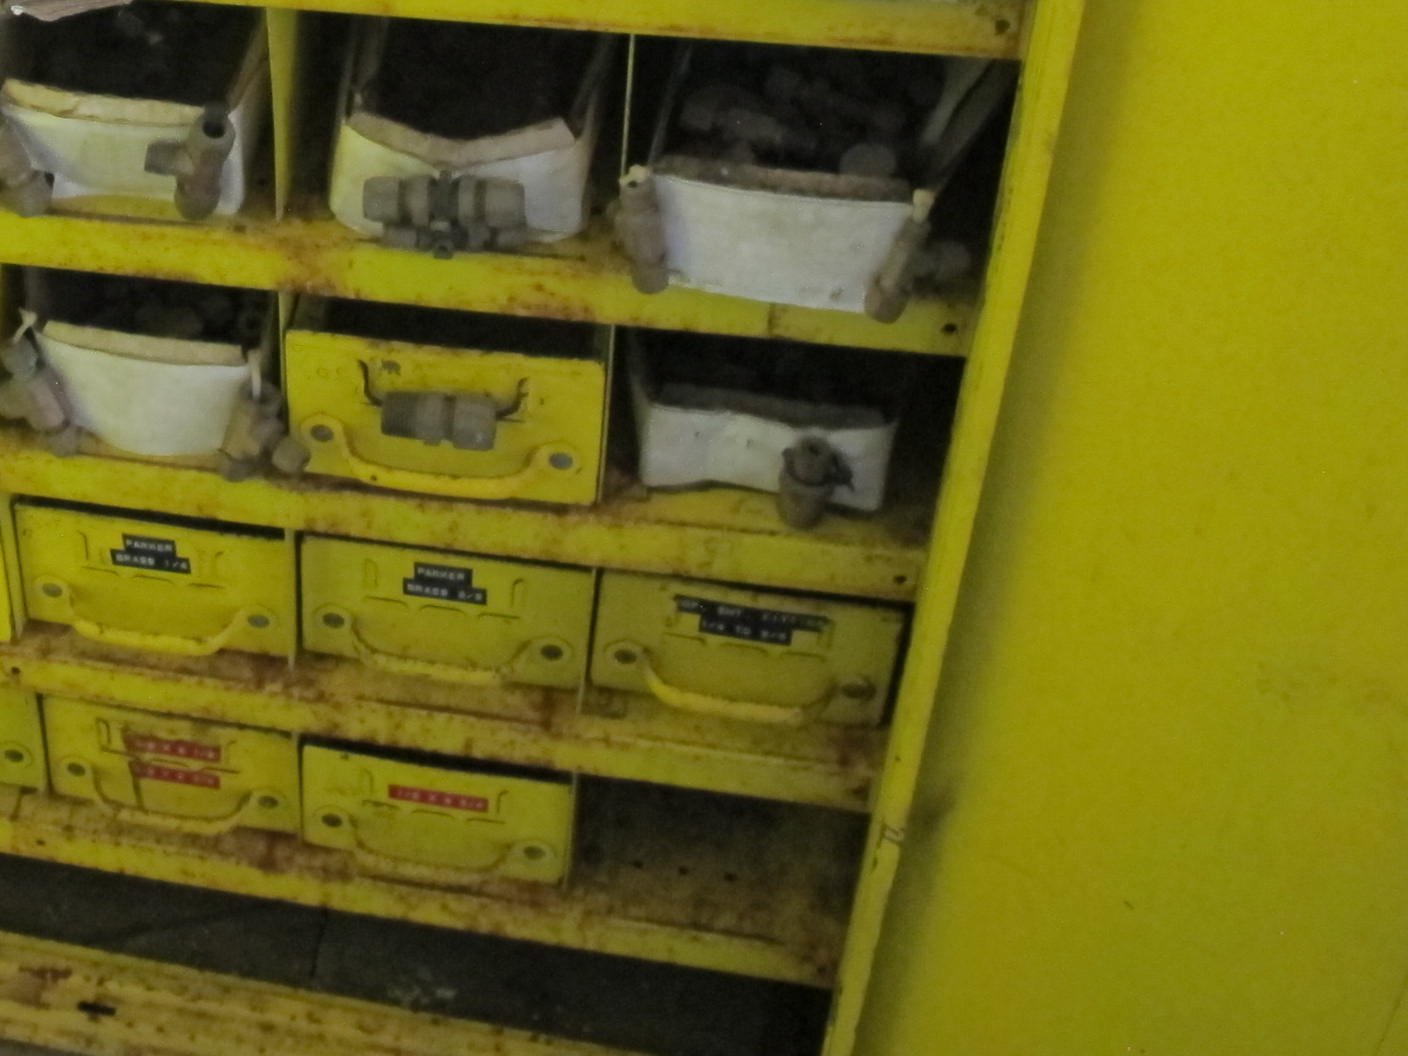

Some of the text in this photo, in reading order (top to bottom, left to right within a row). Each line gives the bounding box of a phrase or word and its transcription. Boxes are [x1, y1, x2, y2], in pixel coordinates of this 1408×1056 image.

[125, 538, 173, 552] PARKER
[115, 553, 155, 565] BRASS
[417, 567, 465, 580] PARKER
[406, 583, 449, 597] BRASS
